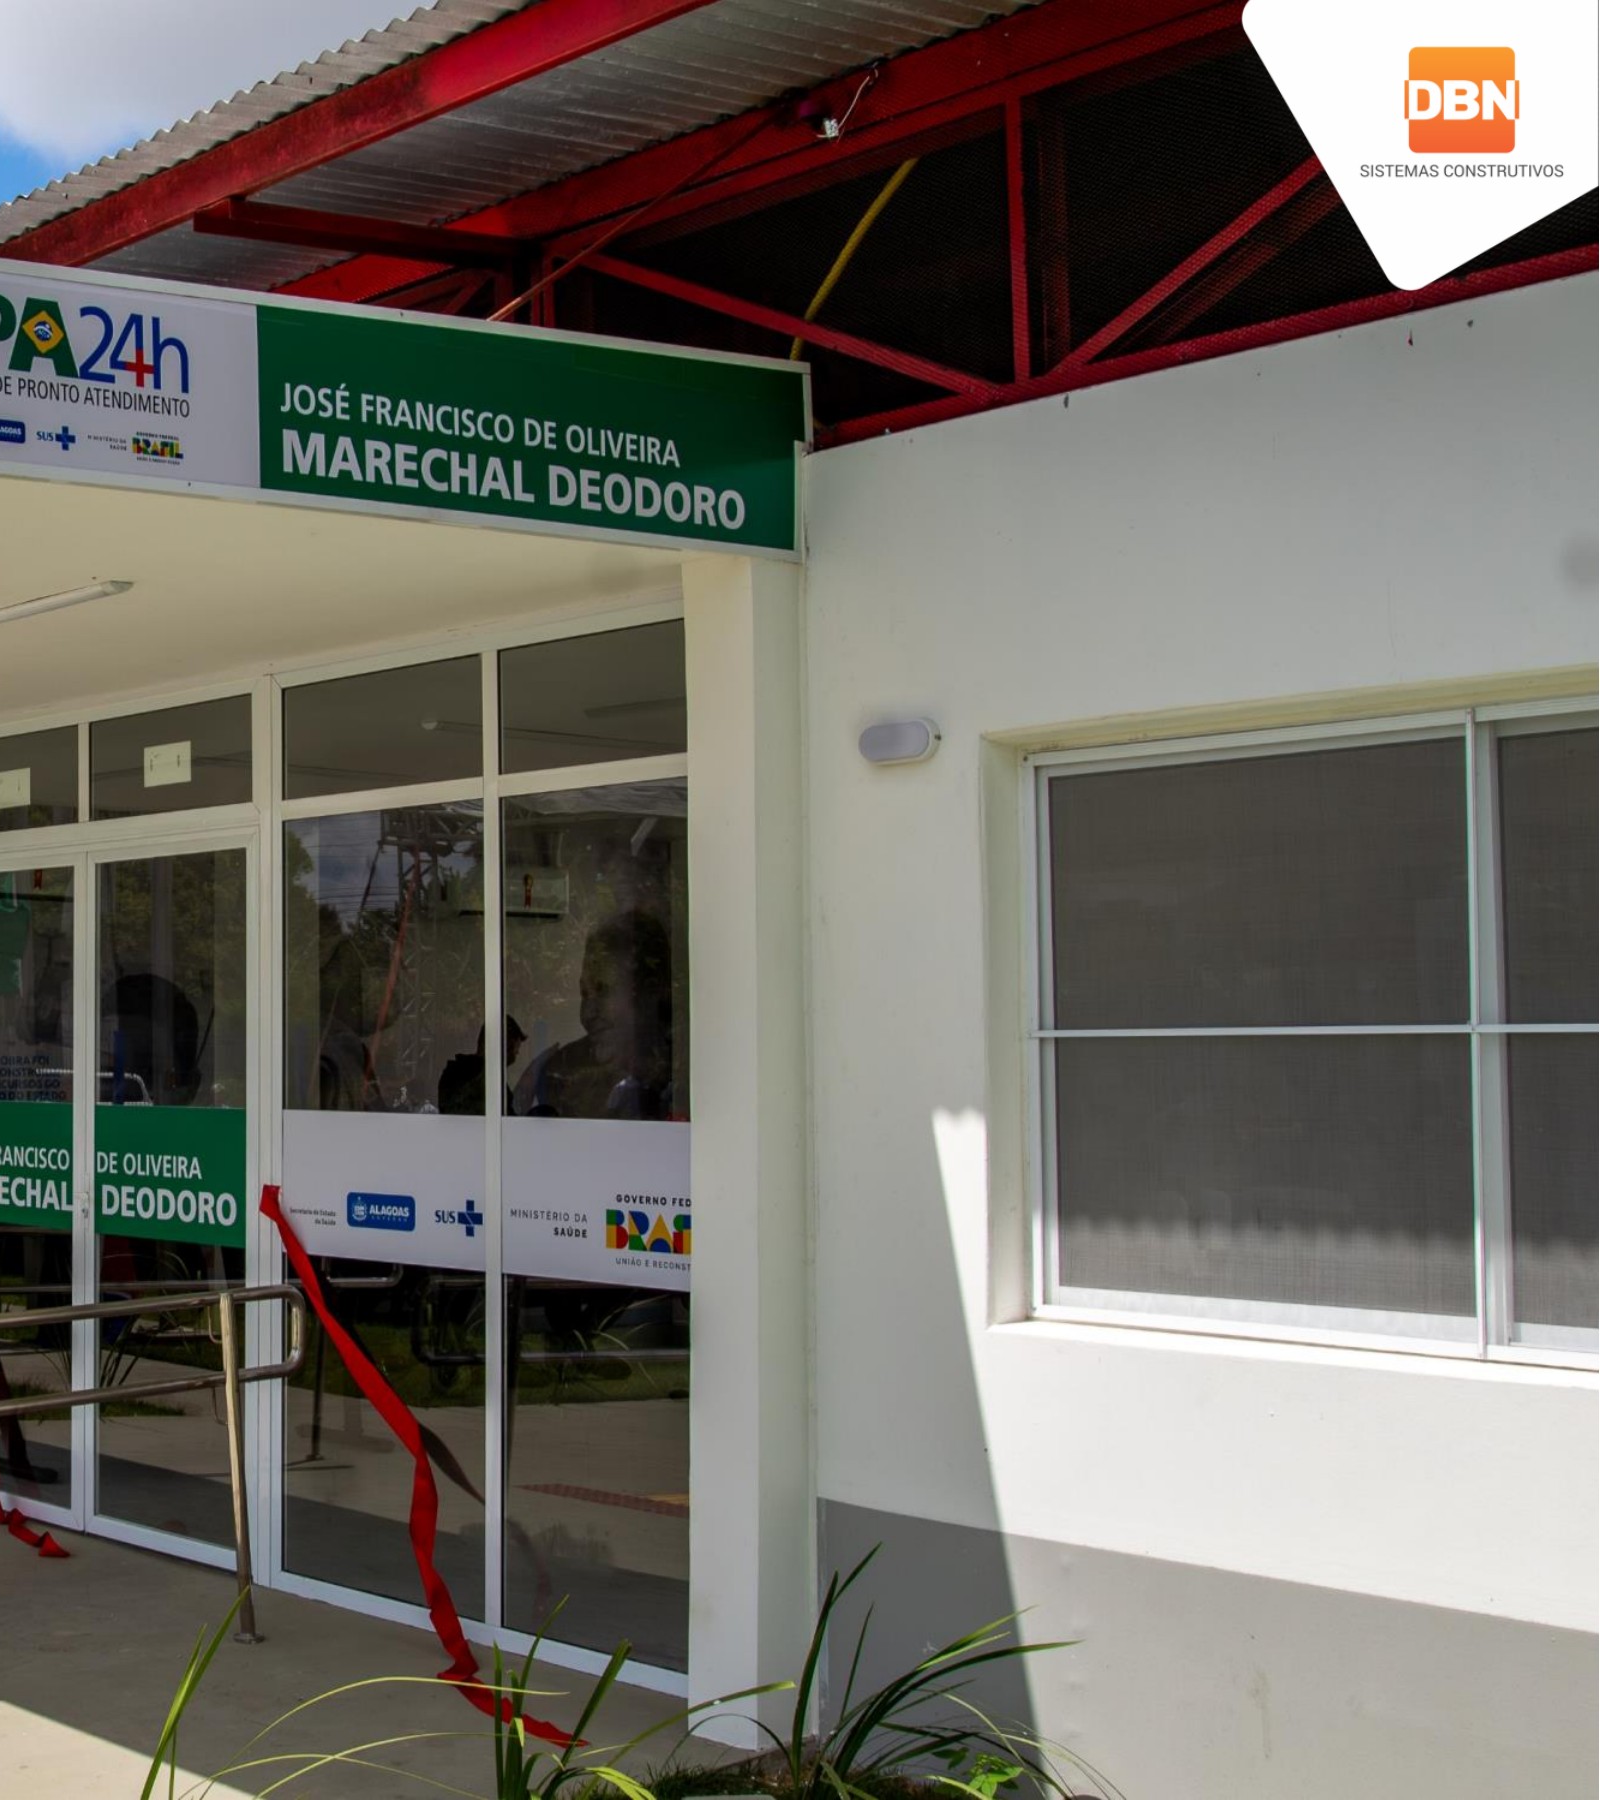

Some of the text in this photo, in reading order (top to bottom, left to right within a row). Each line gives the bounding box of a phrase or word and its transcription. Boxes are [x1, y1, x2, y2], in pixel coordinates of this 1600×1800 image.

[79, 305, 190, 394] 24h
[18, 378, 80, 404] PRONTO
[84, 385, 190, 418] ATENDIMENTO
[281, 382, 681, 468] JOSÉ FRANCISCO DE OLIVEIRA
[36, 431, 54, 442] SUS
[132, 437, 184, 459] BRASIL
[282, 428, 746, 530] MARECHAL DEODORO
[97, 1151, 118, 1174] DE
[123, 1153, 202, 1180] OLIVEIRA
[102, 1184, 237, 1227] DEODORO
[616, 1194, 667, 1206] GOVERNO
[369, 1204, 409, 1217] ALAGOAS
[435, 1209, 456, 1224] SUS
[510, 1208, 587, 1223] MINISTÉRIO DA
[553, 1226, 587, 1239] SAÚDE
[616, 1257, 642, 1267] UNIÃO
[653, 1261, 691, 1271] RECONST
